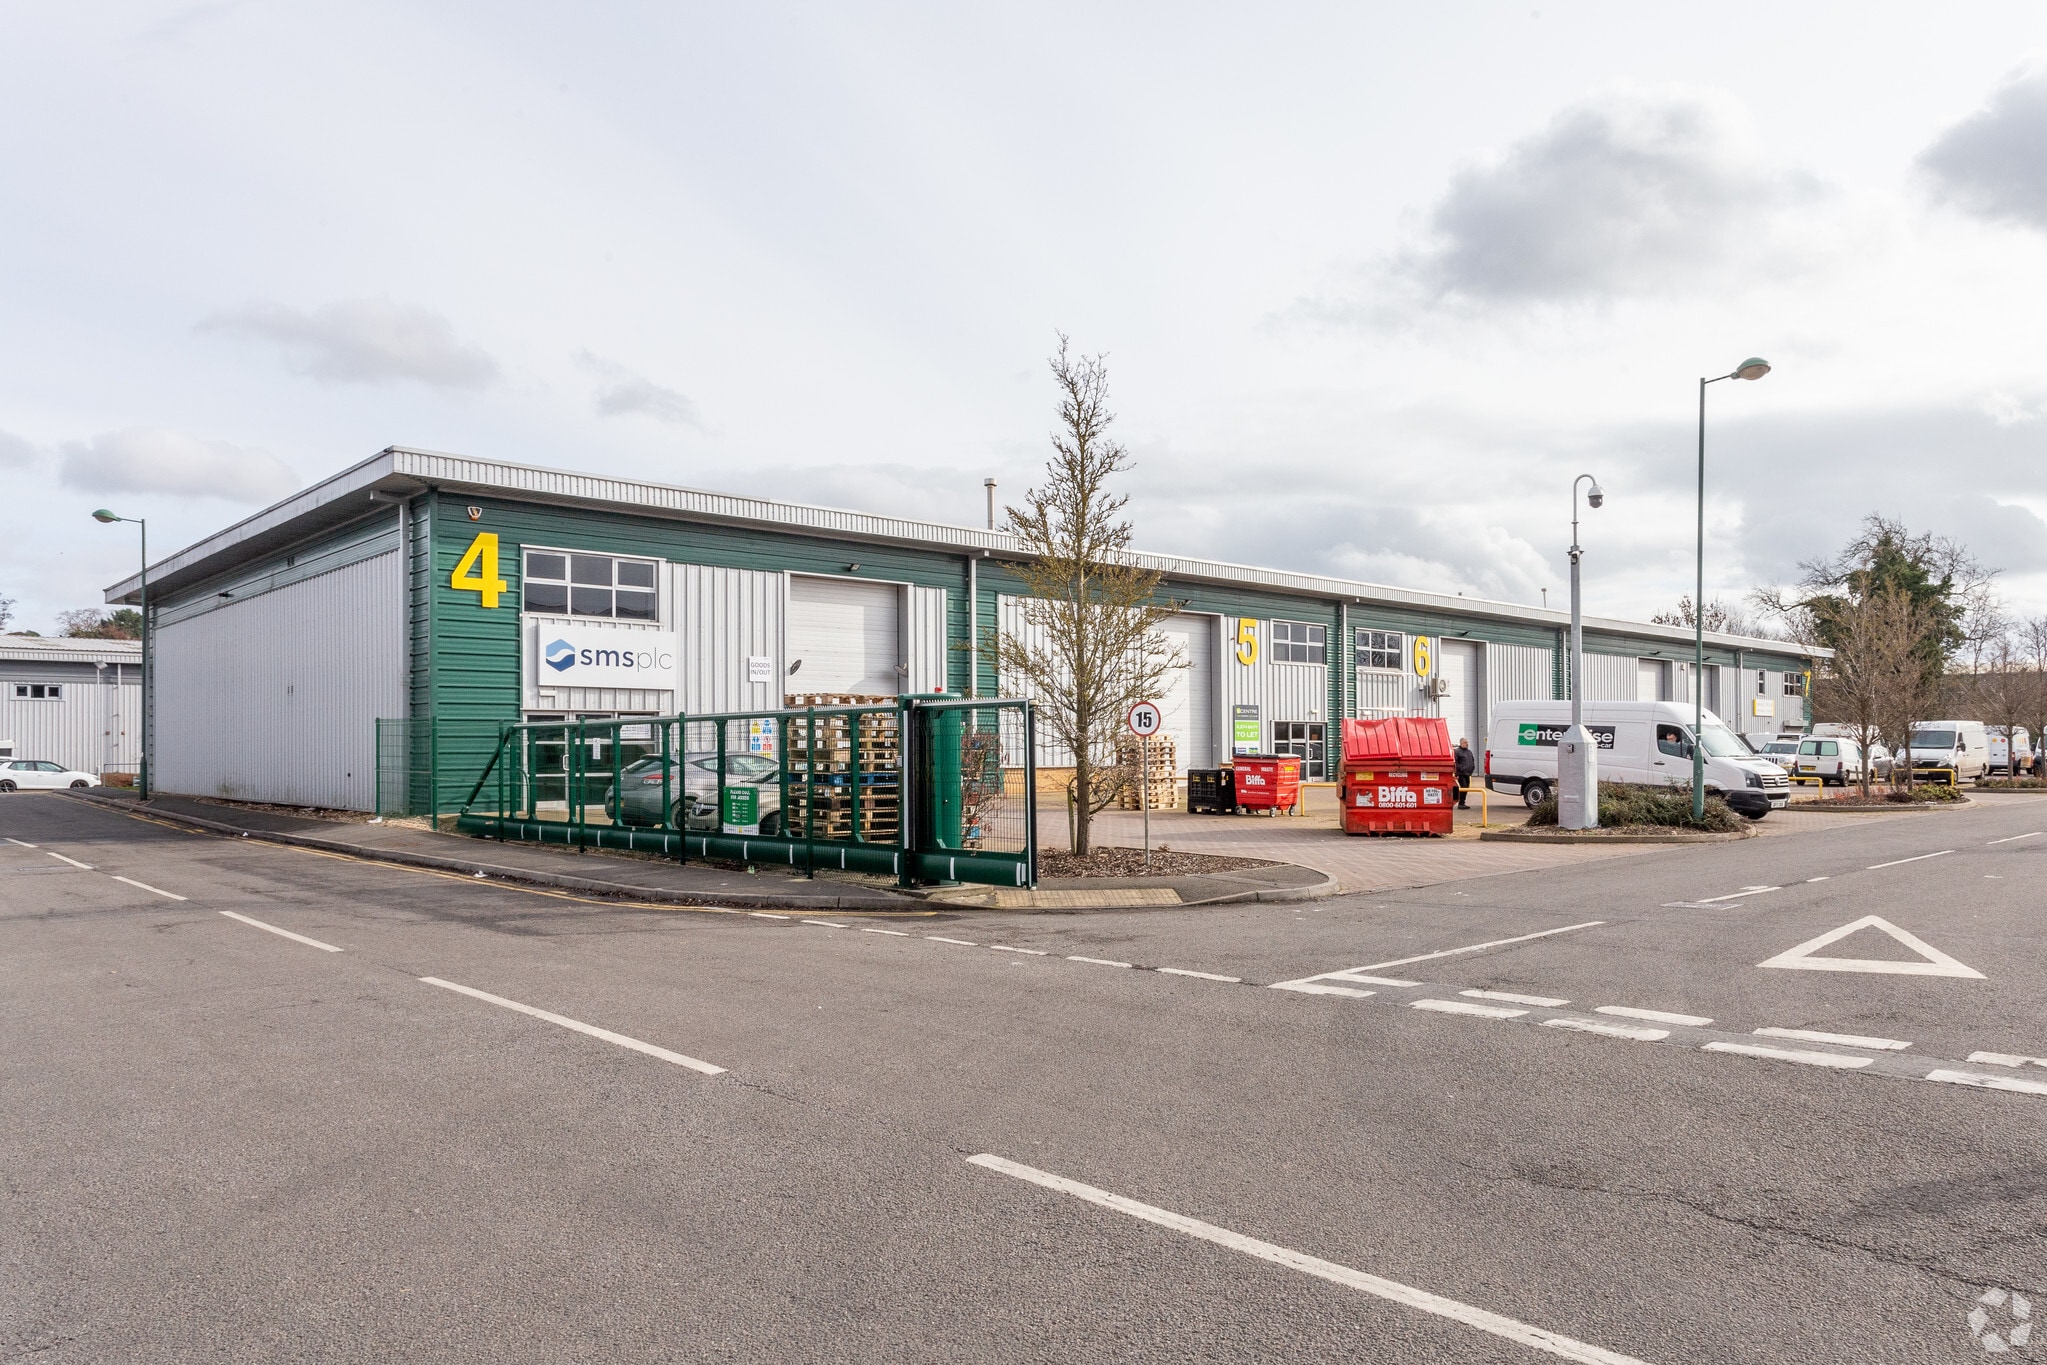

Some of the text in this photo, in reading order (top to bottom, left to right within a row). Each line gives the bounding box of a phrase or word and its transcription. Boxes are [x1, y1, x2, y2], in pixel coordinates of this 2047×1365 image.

[451, 532, 507, 609] 4
[1236, 617, 1258, 666] 5
[1413, 635, 1431, 677] 6
[1136, 711, 1152, 728] 15
[1522, 728, 1614, 743] enteise
[1245, 774, 1266, 786] Biffa
[1378, 786, 1417, 802] Biffa
